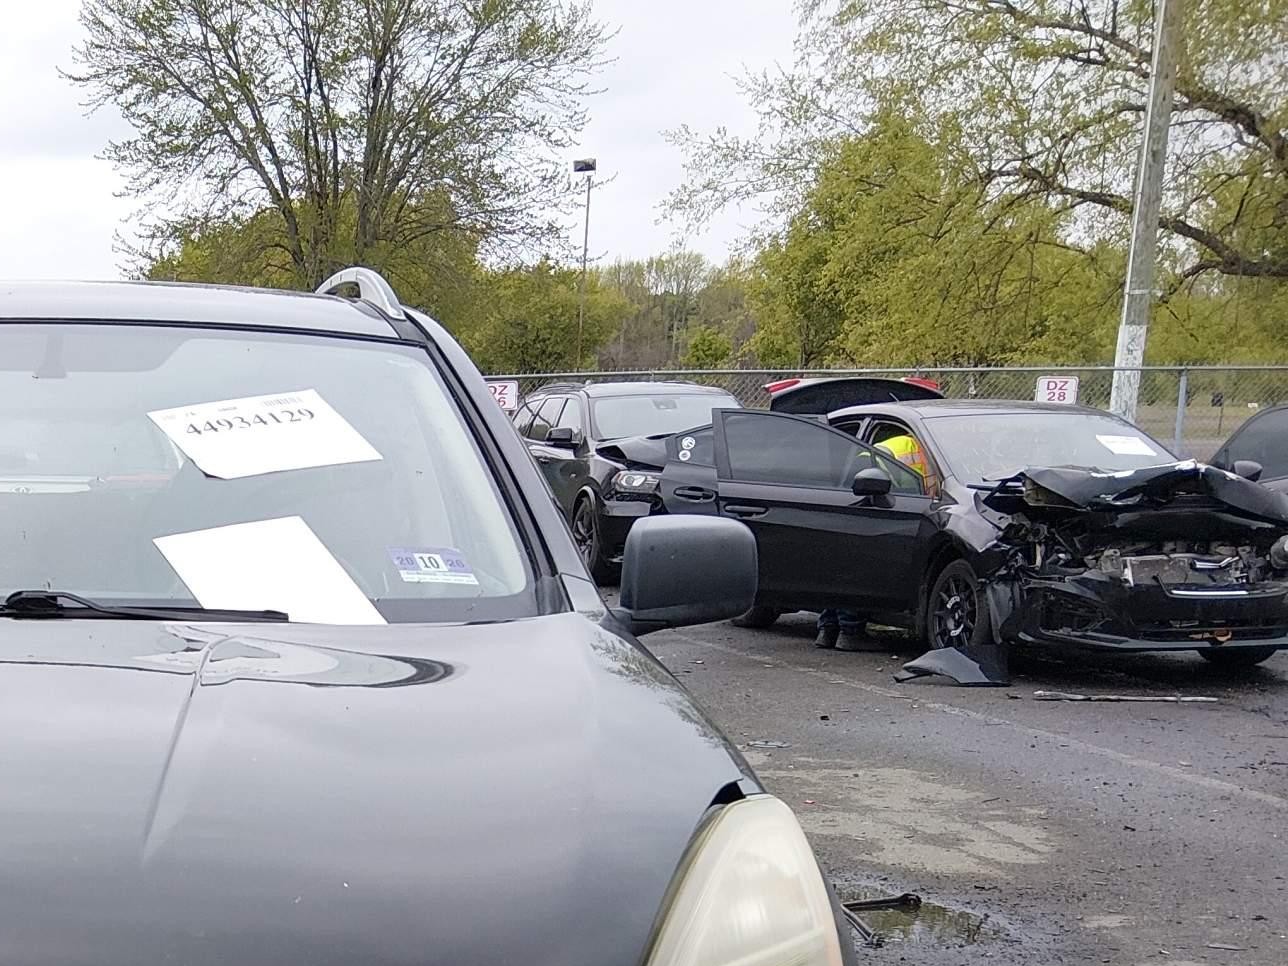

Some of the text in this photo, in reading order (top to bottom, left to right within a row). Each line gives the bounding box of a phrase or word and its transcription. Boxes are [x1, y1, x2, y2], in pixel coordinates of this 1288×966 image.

[1047, 380, 1069, 391] DZ
[1047, 391, 1066, 402] 28
[185, 407, 316, 436] 44934129
[418, 555, 441, 569] 10
